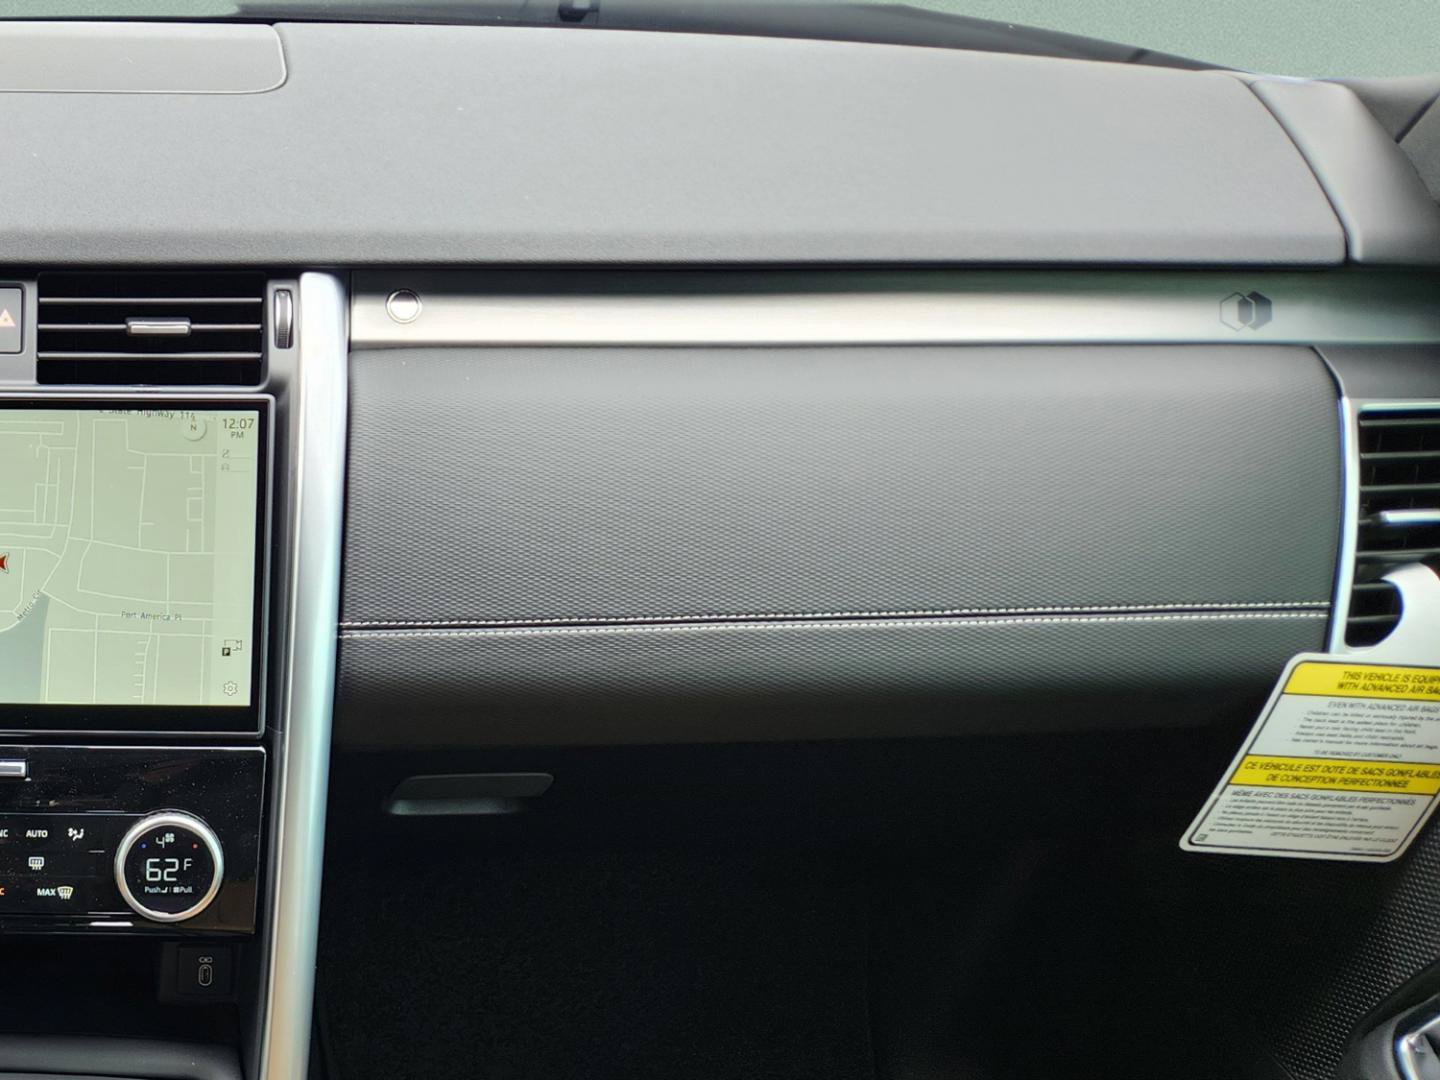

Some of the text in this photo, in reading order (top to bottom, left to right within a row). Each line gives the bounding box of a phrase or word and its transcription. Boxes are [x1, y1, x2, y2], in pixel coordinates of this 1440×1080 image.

[222, 418, 255, 430] 12:07
[1342, 670, 1362, 680] THIS
[1363, 671, 1401, 682] VEHICLE
[1337, 682, 1360, 691] WITH
[1361, 683, 1408, 692] ADVANCED
[1410, 685, 1425, 693] AIR
[26, 830, 48, 838] AUTO
[146, 858, 192, 881] 62 F
[37, 887, 56, 896] MAX
